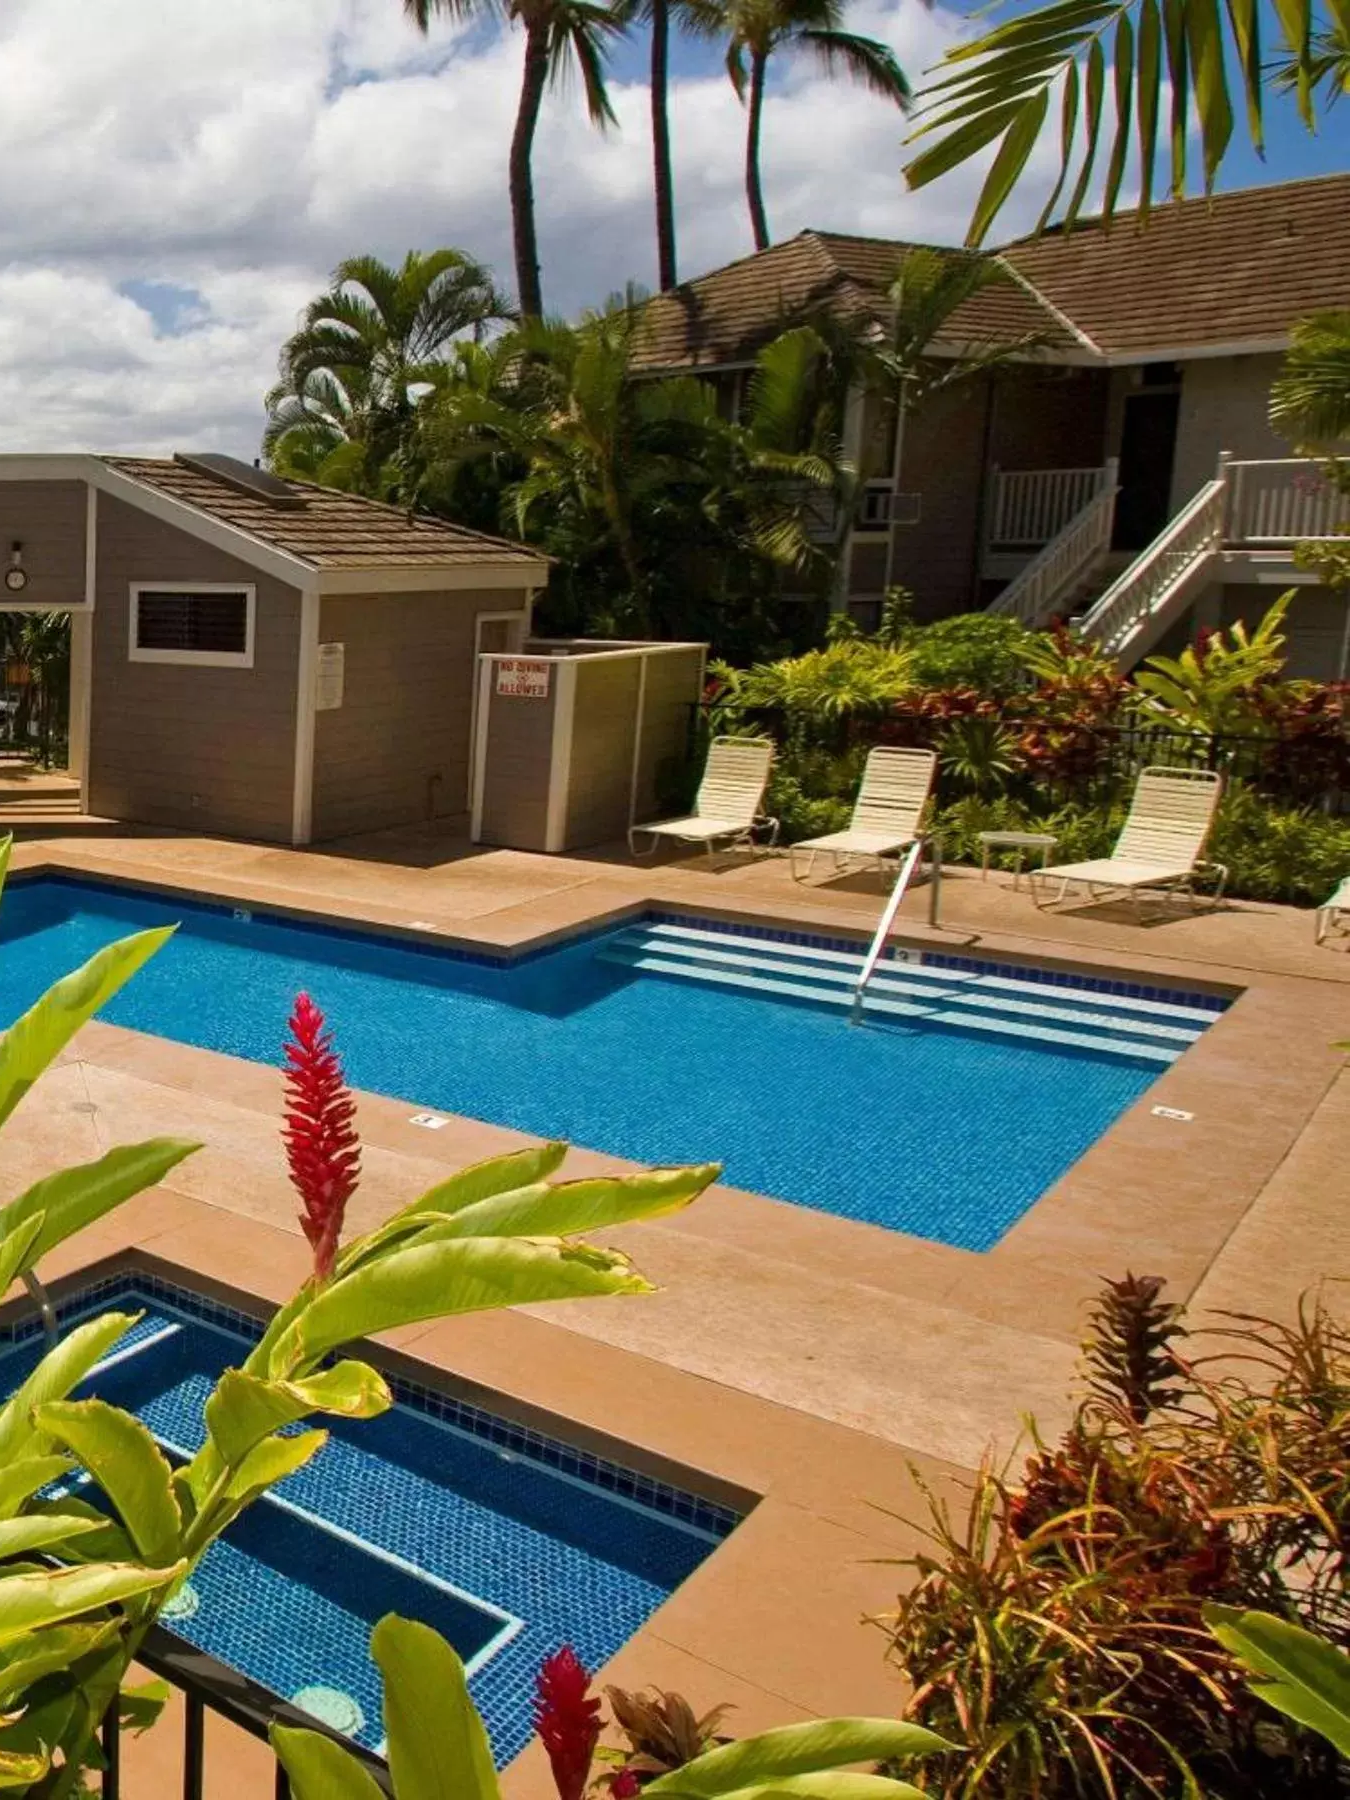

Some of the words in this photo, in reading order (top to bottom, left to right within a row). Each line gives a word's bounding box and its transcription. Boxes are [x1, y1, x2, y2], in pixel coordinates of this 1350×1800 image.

[500, 661, 514, 672] NO
[517, 661, 547, 673] DIVING
[498, 683, 544, 695] ALLOWED
